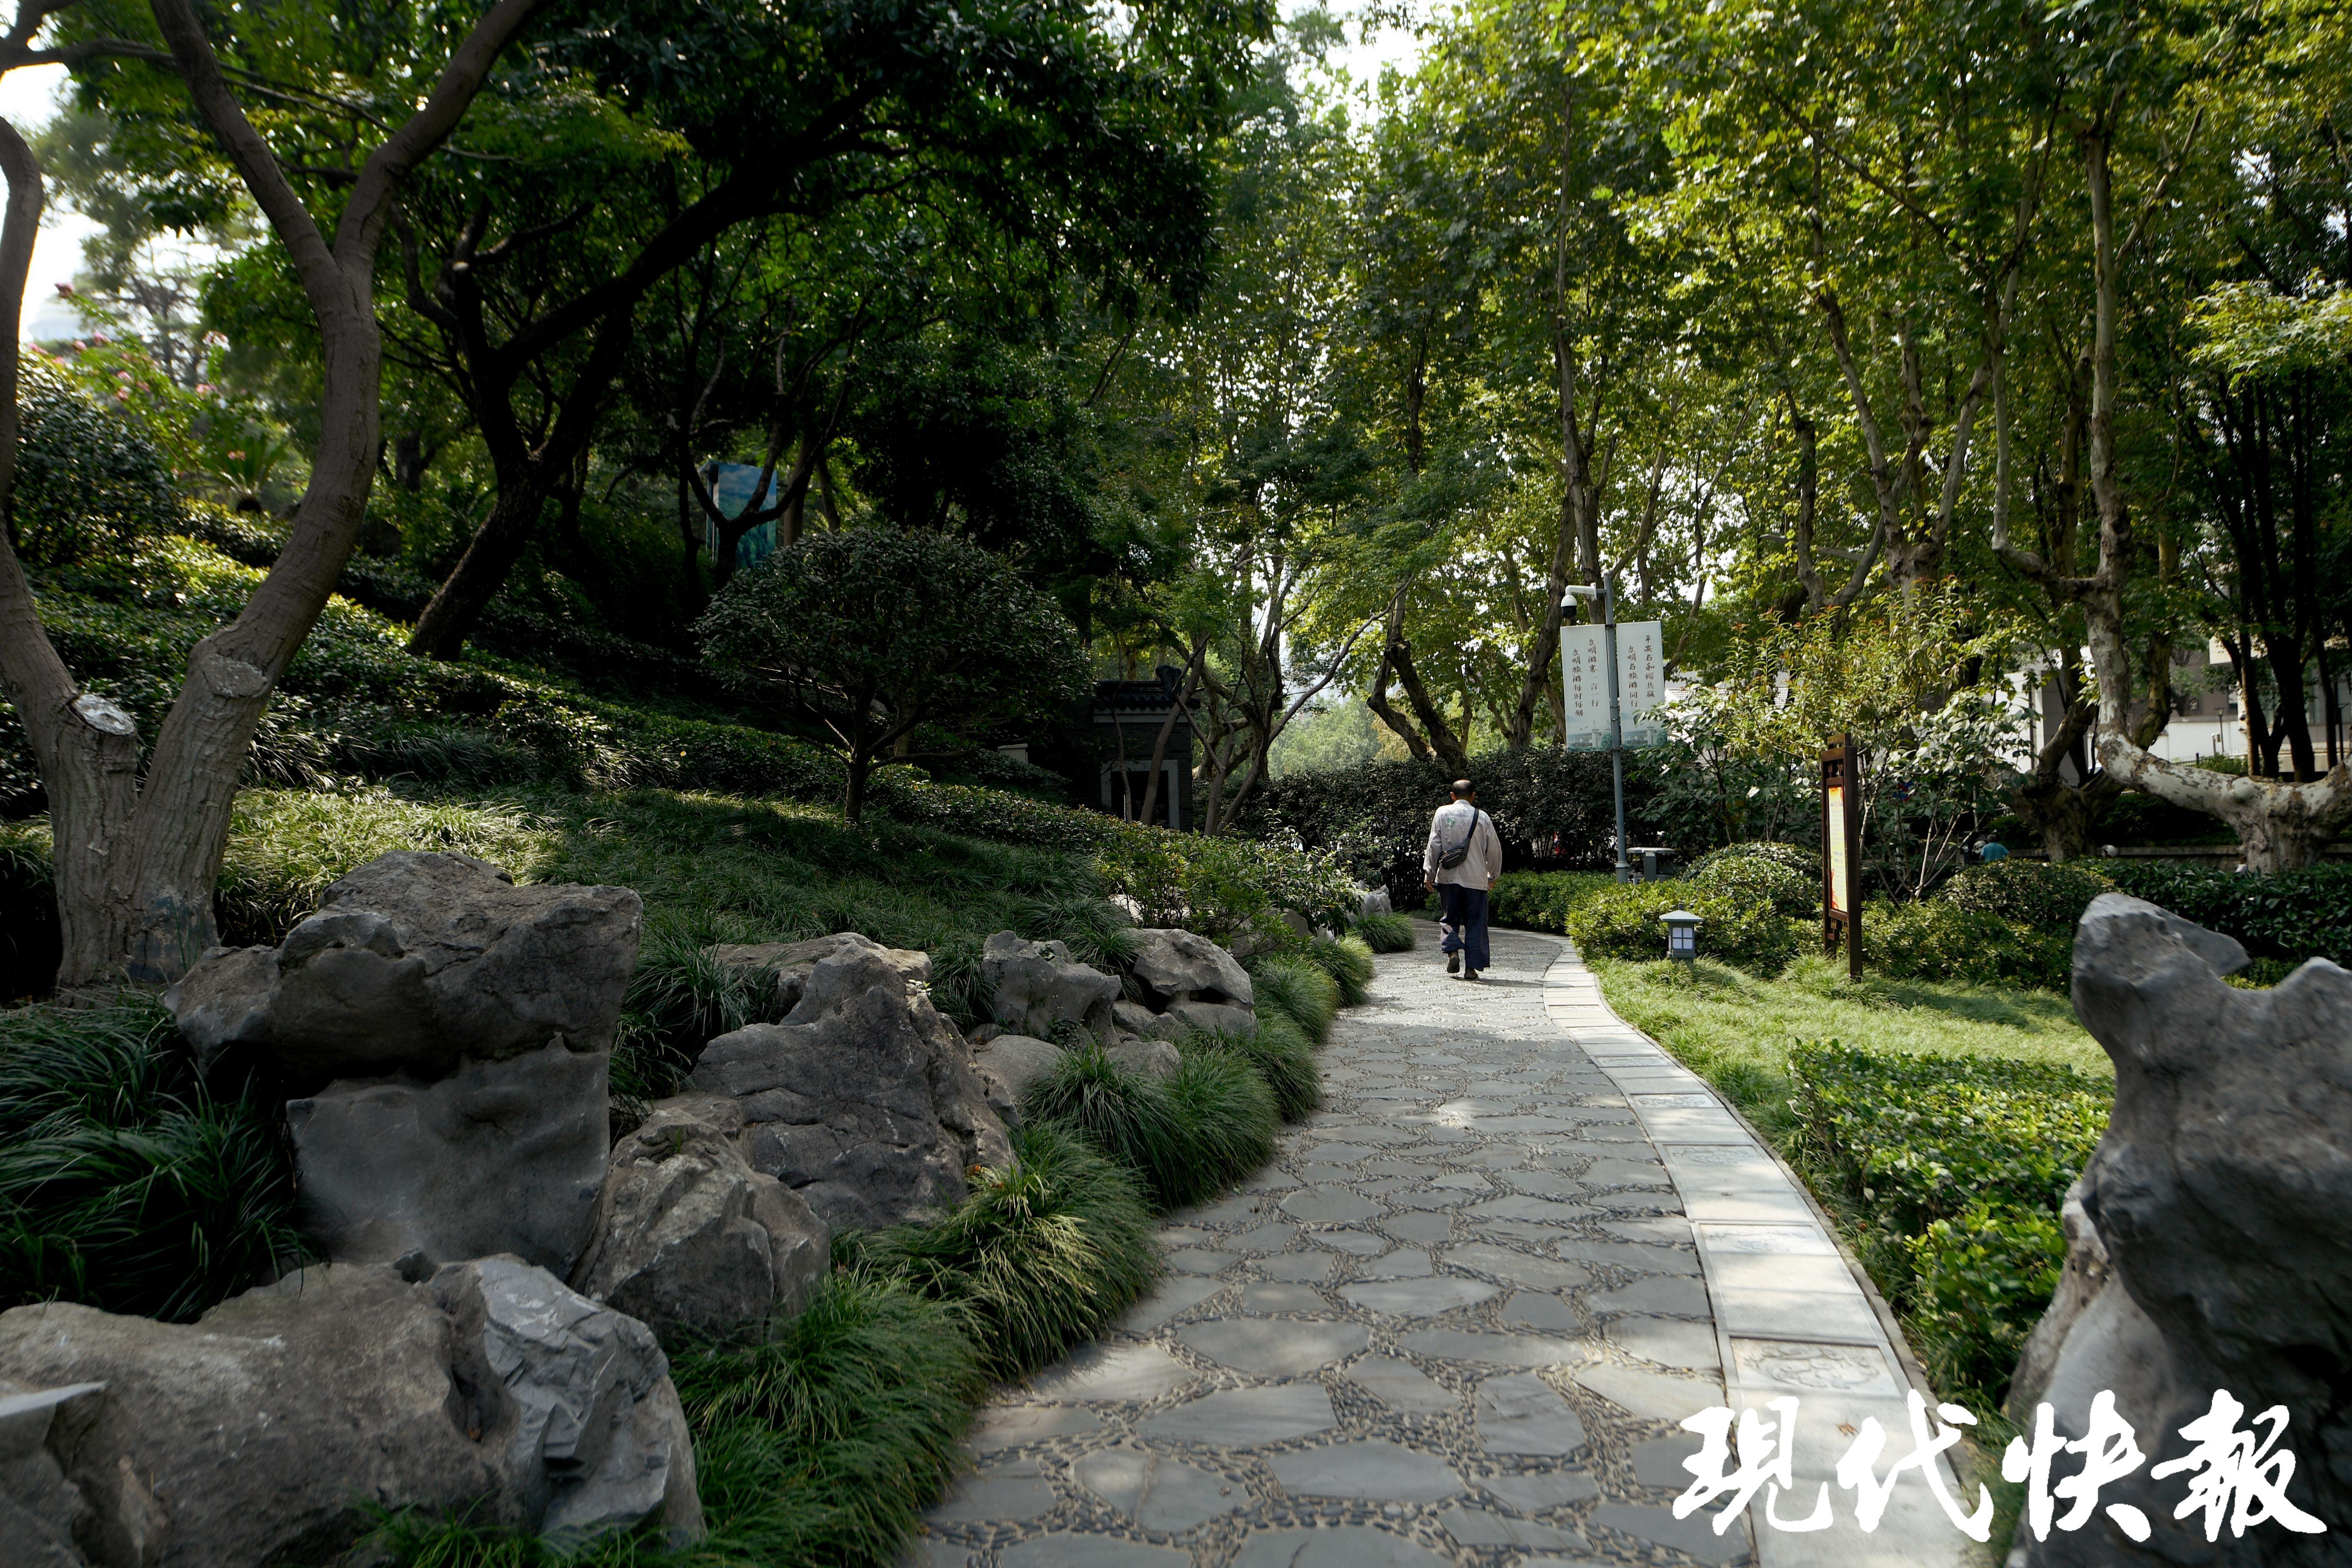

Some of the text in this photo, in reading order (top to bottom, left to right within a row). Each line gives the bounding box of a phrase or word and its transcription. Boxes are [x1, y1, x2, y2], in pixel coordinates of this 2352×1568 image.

[1572, 649, 1583, 716] 文明旅游每时每刻
[1588, 639, 1599, 706] 文明游客一言一行
[1628, 646, 1638, 707] 文明与旅游同行
[1644, 635, 1655, 697] 平安与和谐共赢
